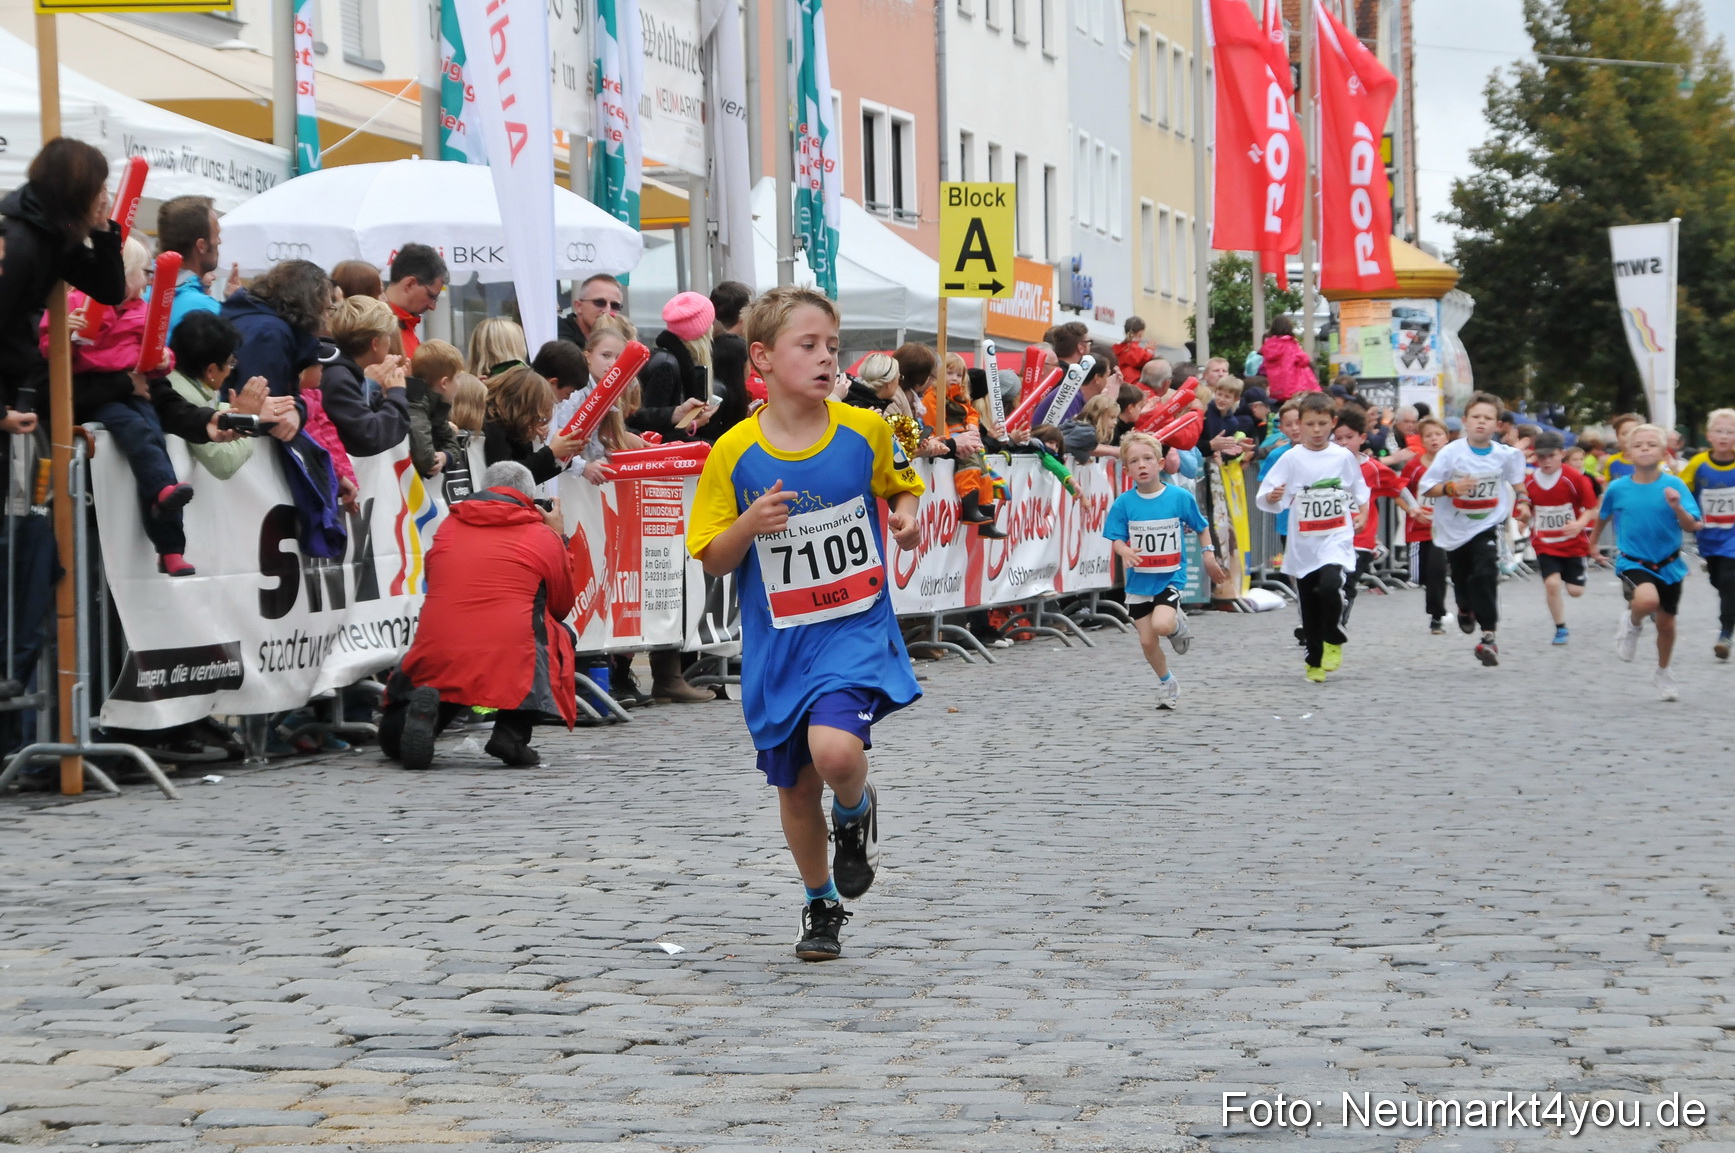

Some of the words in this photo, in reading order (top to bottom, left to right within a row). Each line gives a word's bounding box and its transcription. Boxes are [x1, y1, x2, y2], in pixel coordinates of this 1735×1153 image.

[228, 160, 252, 191] Audi
[948, 186, 1006, 207] Block
[453, 246, 504, 263] BKK
[954, 217, 997, 273] A
[1054, 383, 1072, 407] BMW
[570, 410, 588, 432] Audi
[585, 392, 602, 412] BKK
[619, 463, 643, 472] Audi
[645, 461, 665, 470] BKK
[1302, 498, 1342, 518] 7026
[799, 513, 853, 537] Neumarkt
[1134, 531, 1177, 553] 7071
[770, 526, 869, 585] 7109
[1149, 558, 1167, 566] Leon
[812, 587, 850, 607] Luca
[170, 663, 188, 684] die
[190, 659, 240, 681] verbinden
